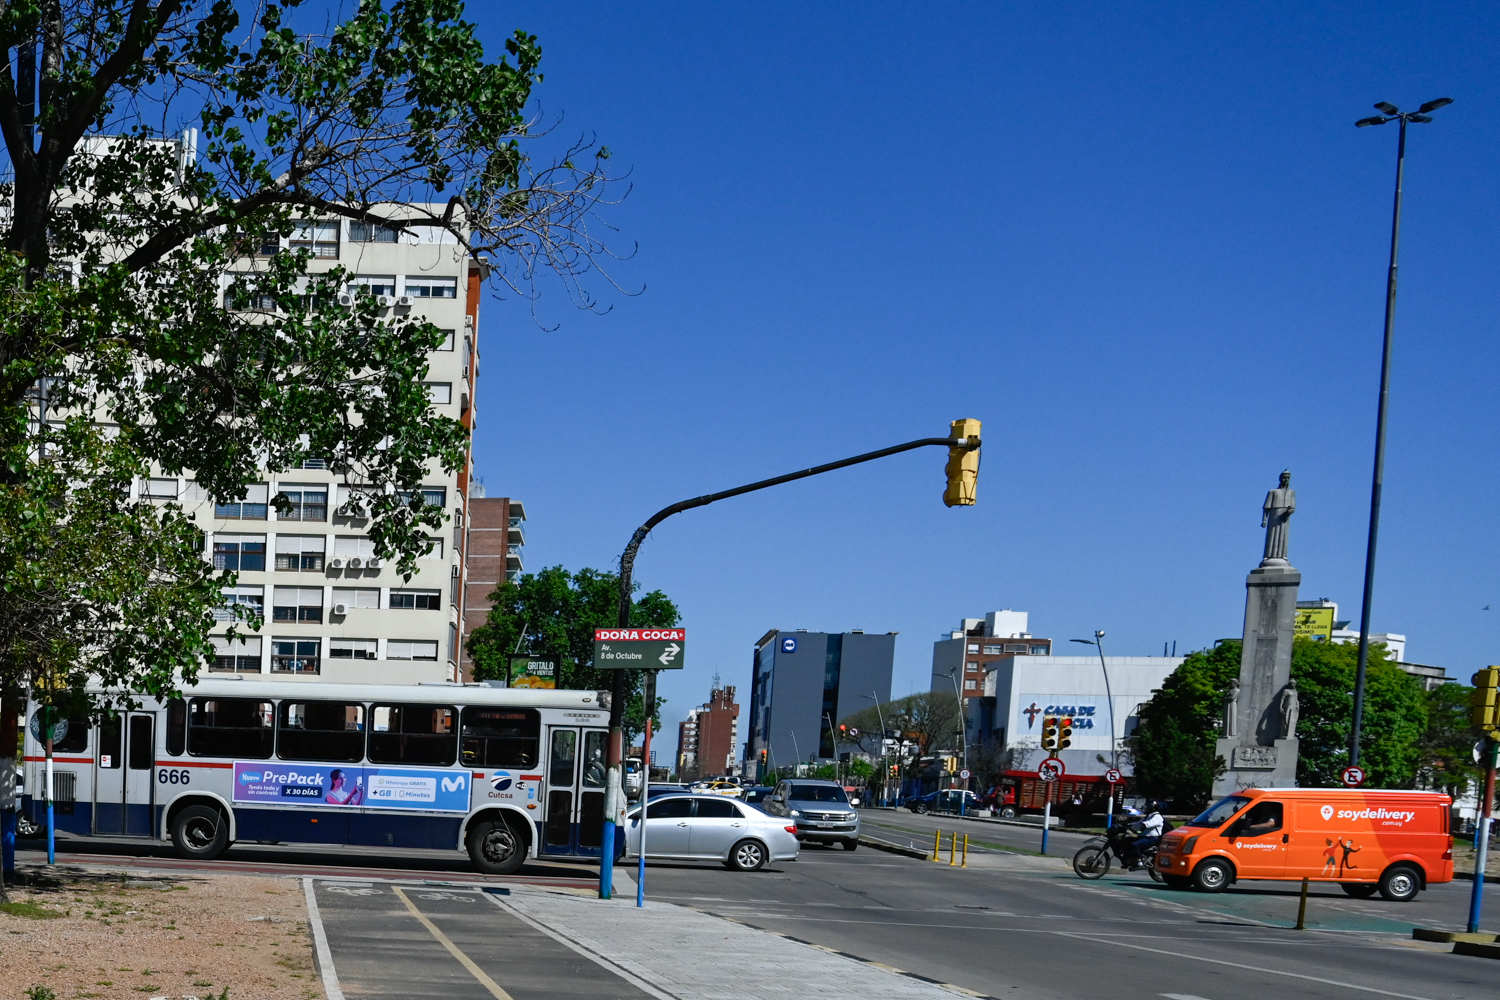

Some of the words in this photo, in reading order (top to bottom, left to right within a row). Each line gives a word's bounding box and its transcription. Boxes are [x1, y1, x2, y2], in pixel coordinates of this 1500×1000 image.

[600, 630, 639, 639] DOÑA
[642, 631, 679, 639] COCA
[1044, 705, 1077, 717] CASA
[1078, 706, 1096, 716] DE
[158, 769, 190, 785] 666
[242, 773, 259, 781] Nuevo
[263, 770, 324, 785] PrePack
[302, 788, 318, 796] DÍAS
[488, 791, 513, 799] Cutcsa
[1337, 808, 1415, 823] soydelivery
